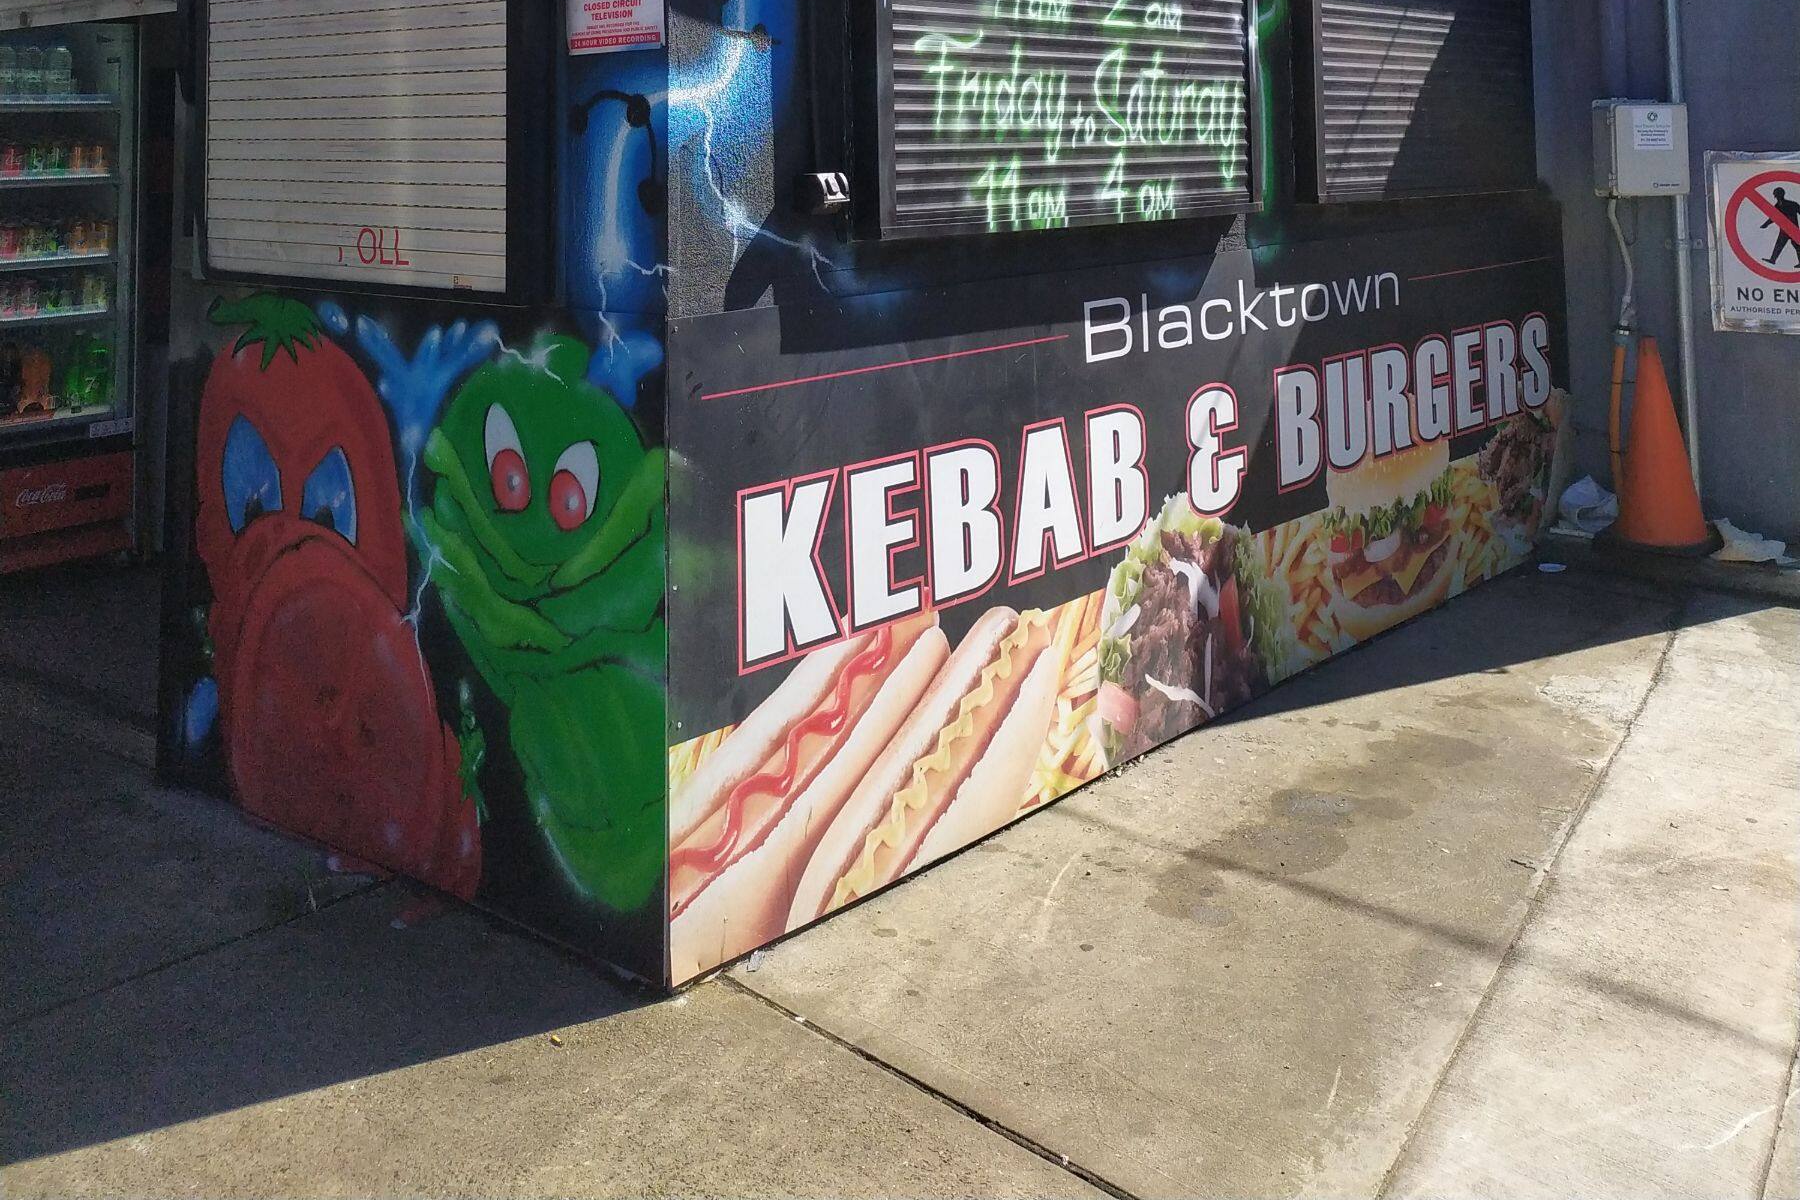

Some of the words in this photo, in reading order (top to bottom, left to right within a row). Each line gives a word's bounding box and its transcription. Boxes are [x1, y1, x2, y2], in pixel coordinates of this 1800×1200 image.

[583, 0, 611, 12] CLOSED
[590, 9, 633, 21] TELEVISION
[600, 37, 617, 46] VIDEO
[618, 34, 657, 44] RECORDING
[915, 29, 1068, 164] Friday
[1069, 99, 1097, 149] to
[1736, 286, 1764, 302] NO
[1773, 288, 1799, 304] EN
[1082, 270, 1400, 364] Blacktown
[1730, 305, 1782, 315] AUTHORISED
[743, 409, 1147, 665] KEBAB
[1188, 388, 1245, 513] &
[1277, 316, 1551, 489] BURGERS
